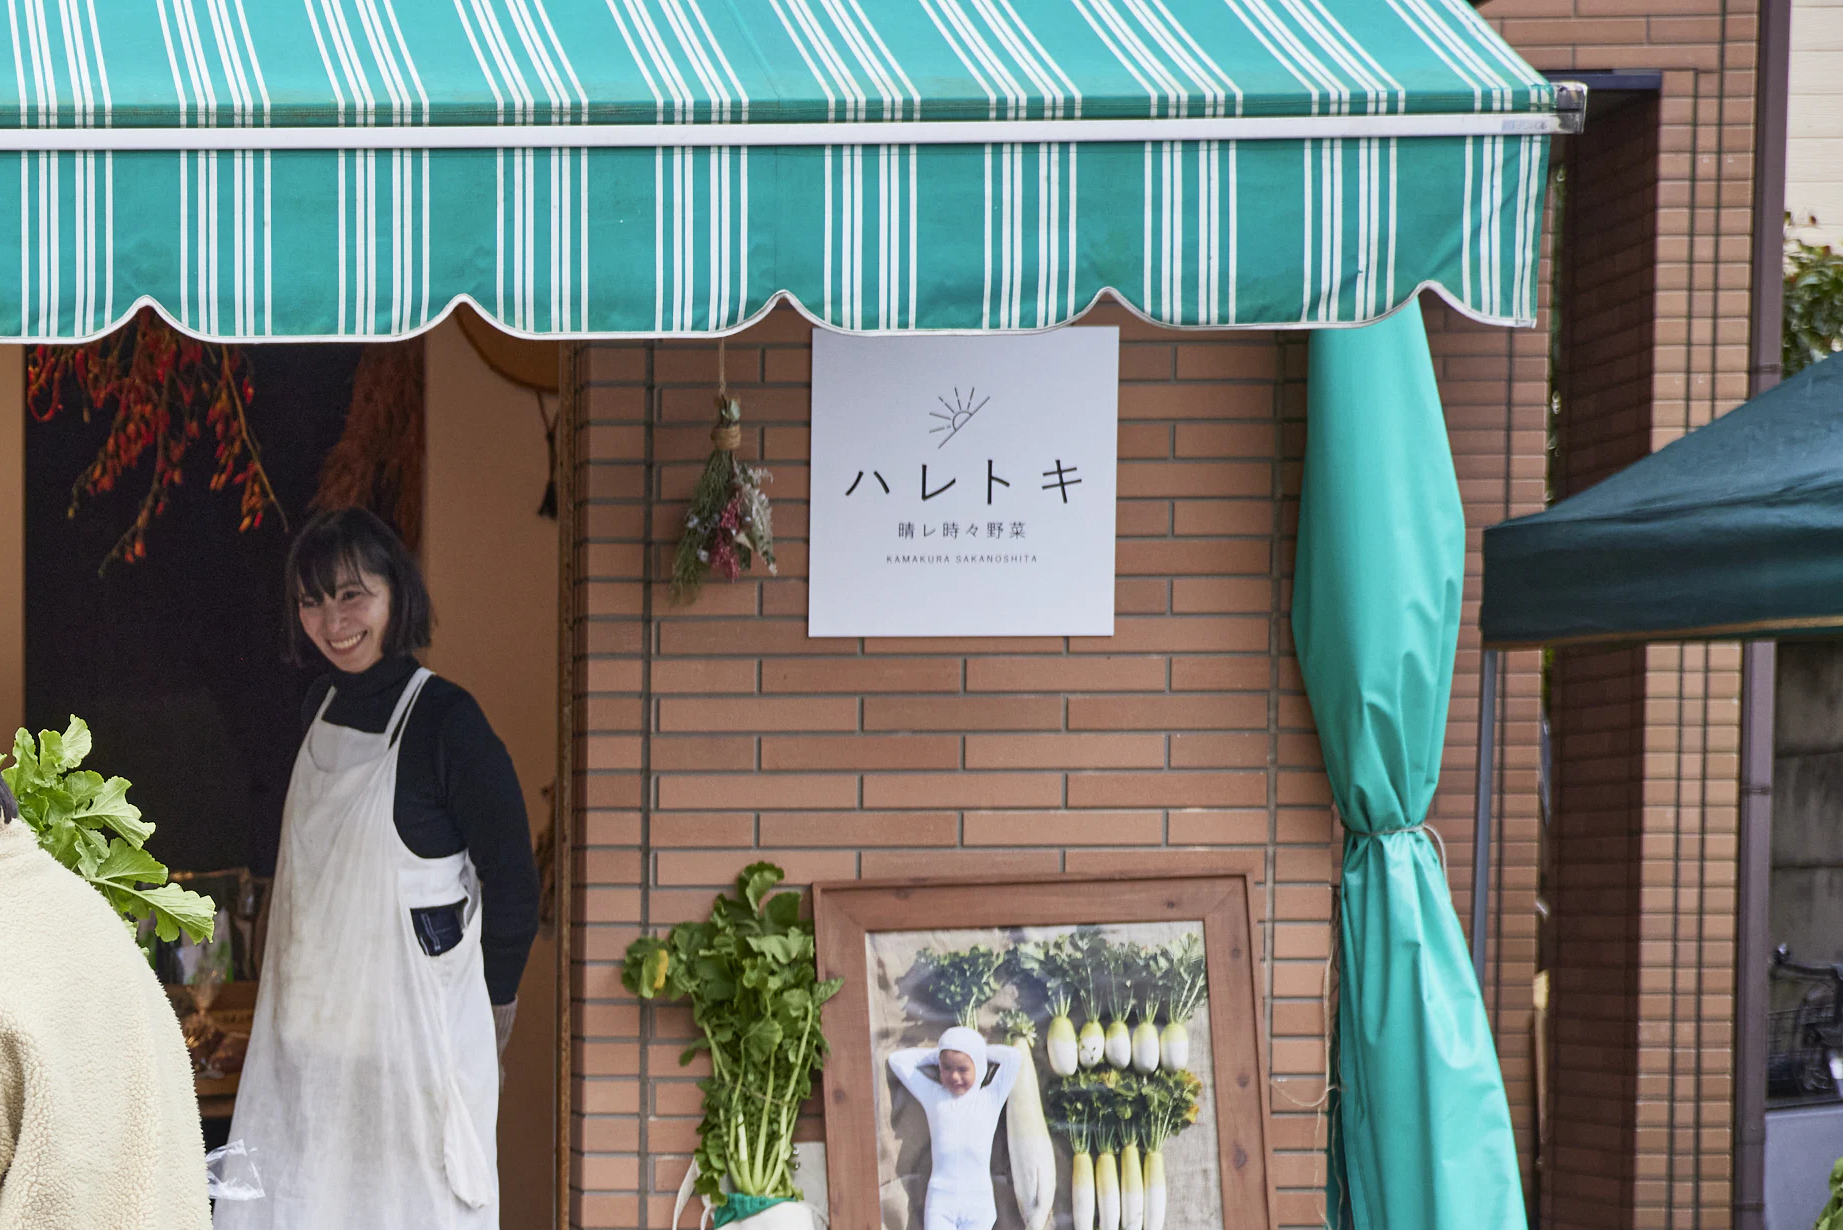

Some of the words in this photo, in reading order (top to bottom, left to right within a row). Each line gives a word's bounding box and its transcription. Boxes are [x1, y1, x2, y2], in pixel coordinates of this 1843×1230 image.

[845, 459, 1082, 505] ハレトキ
[898, 522, 1026, 539] 晴レ時々野菜
[886, 555, 950, 564] KAMAKURA
[955, 555, 1037, 564] SAKANOSHITA
